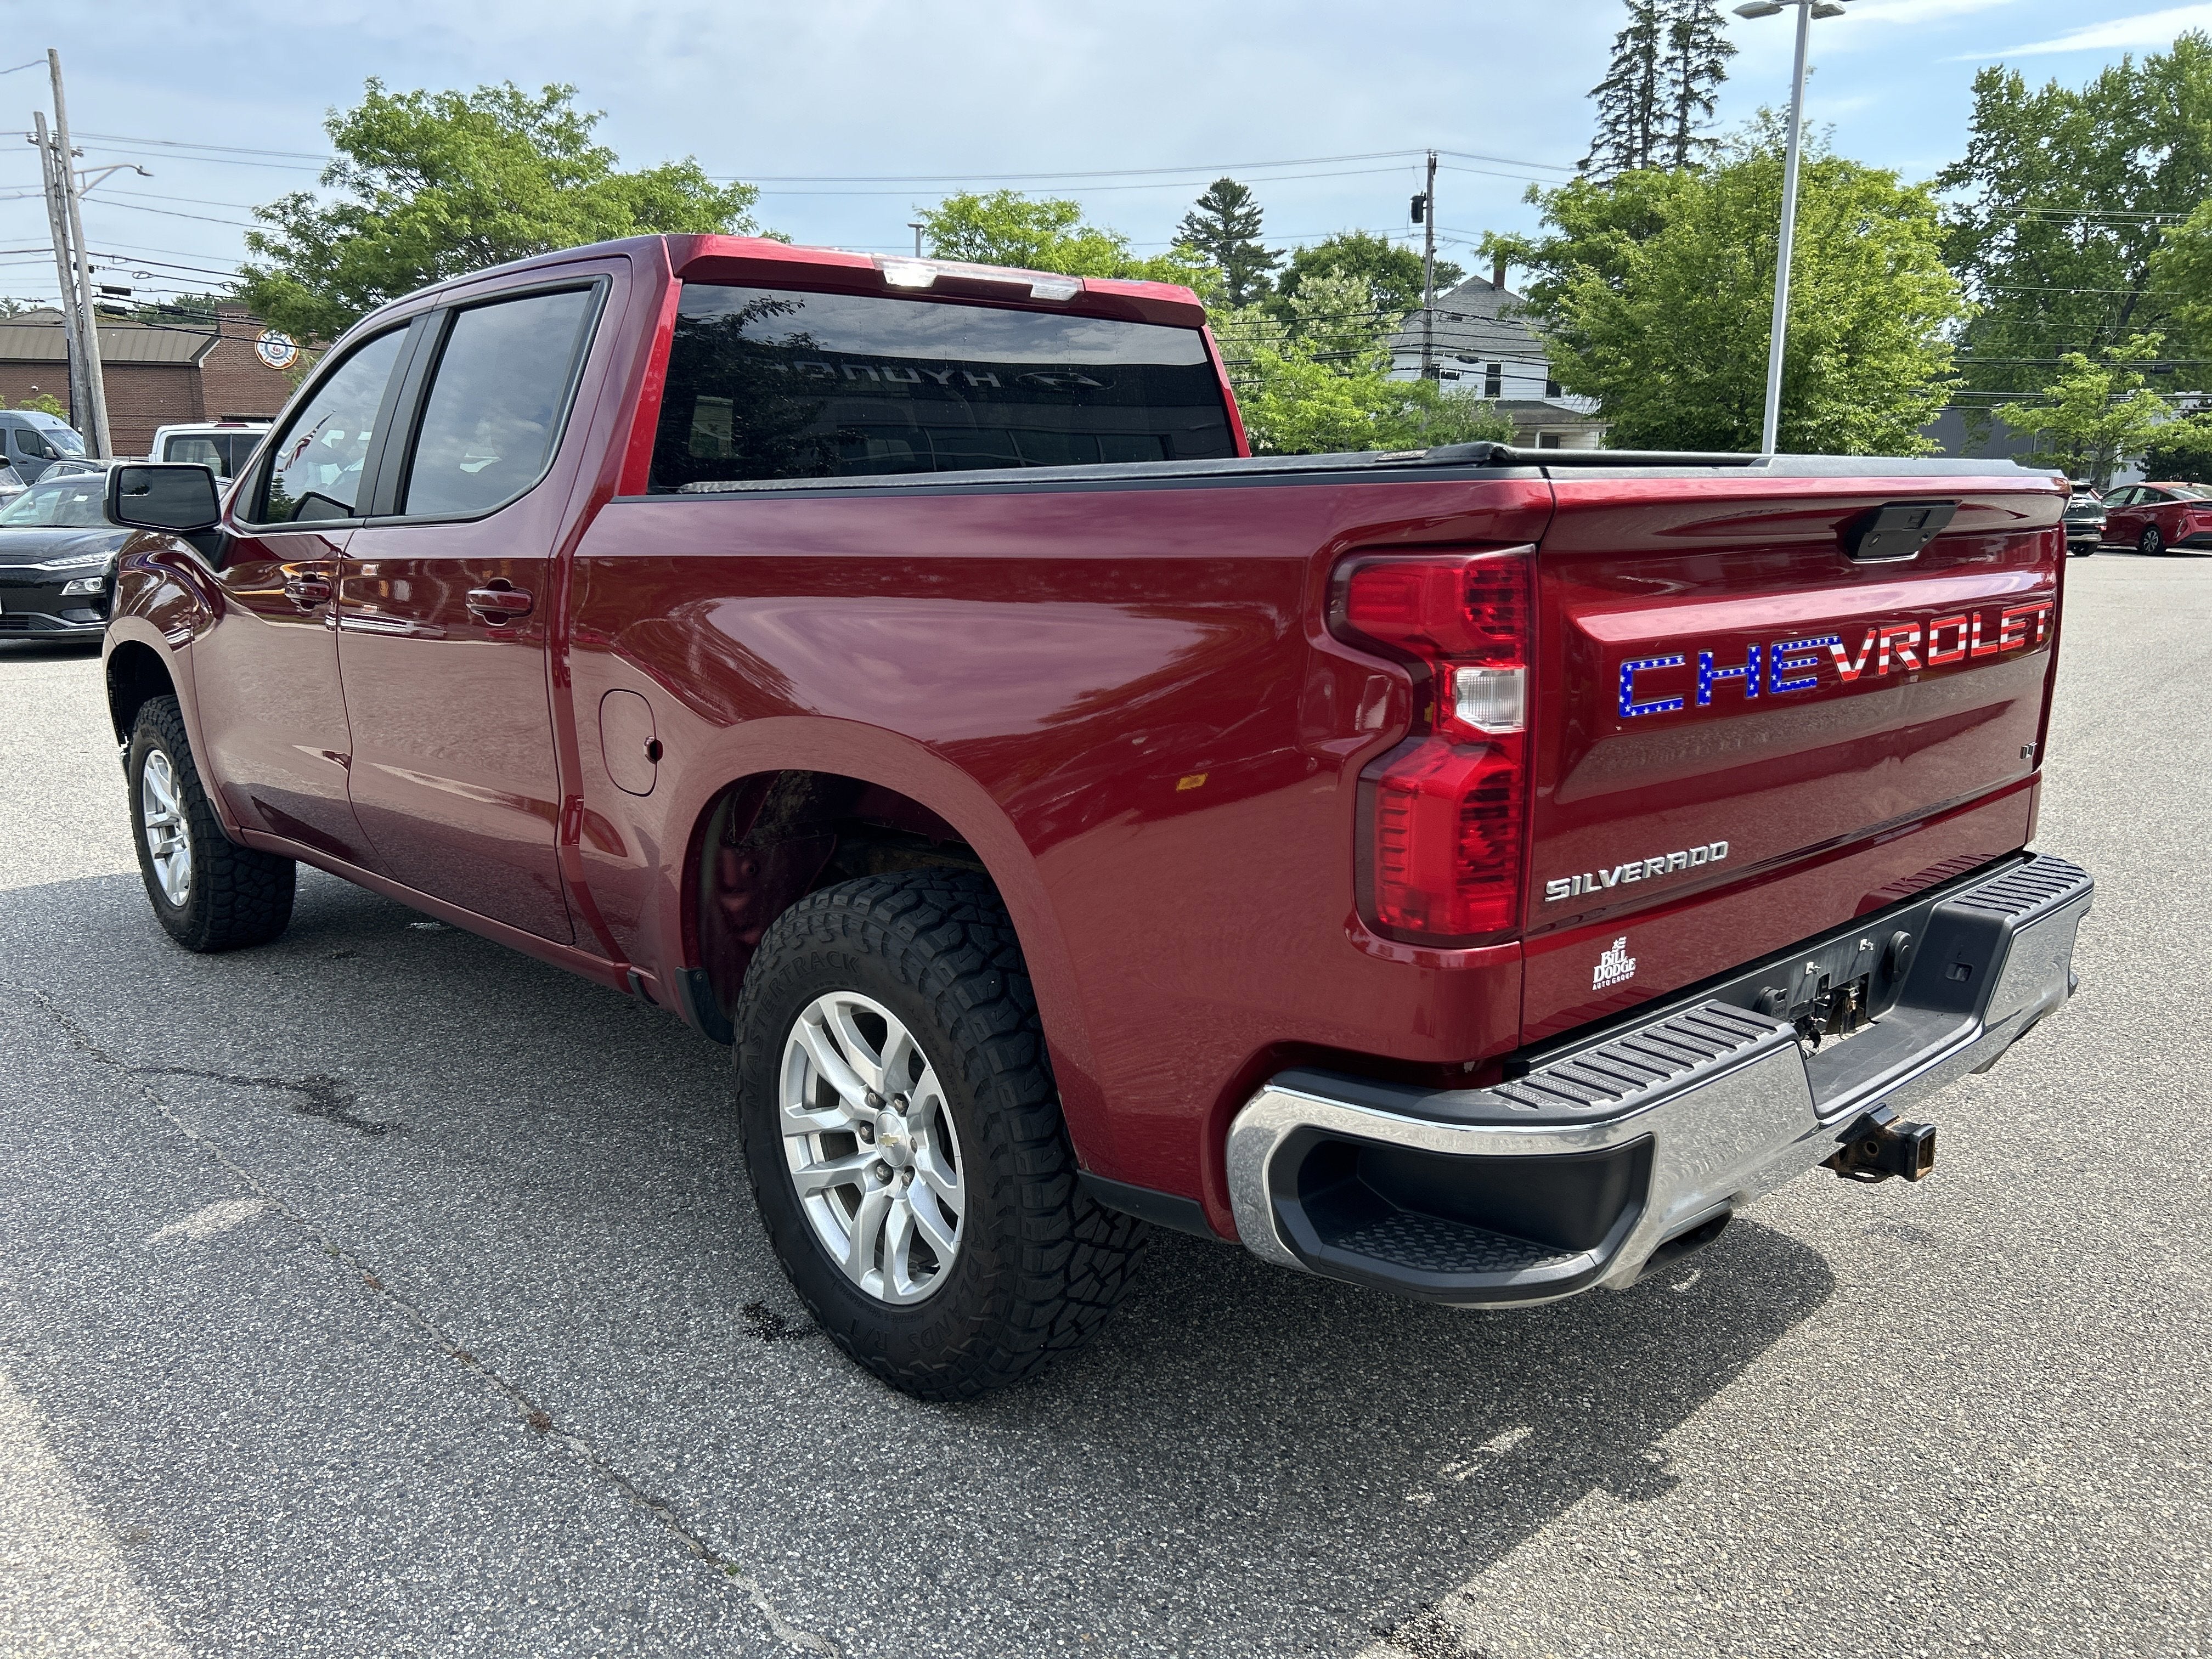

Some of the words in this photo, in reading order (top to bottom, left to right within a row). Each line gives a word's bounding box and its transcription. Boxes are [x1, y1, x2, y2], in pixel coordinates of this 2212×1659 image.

[1619, 602, 2053, 718] CHEVROLET
[2019, 742, 2038, 759] LT
[1544, 841, 1728, 902] SILVERADO
[1593, 958, 1636, 983] DODGE
[1601, 950, 1628, 967] BILL
[1592, 980, 1611, 991] AUTO
[1612, 971, 1634, 984] GROUP
[745, 950, 860, 1111] MASTERTRACK
